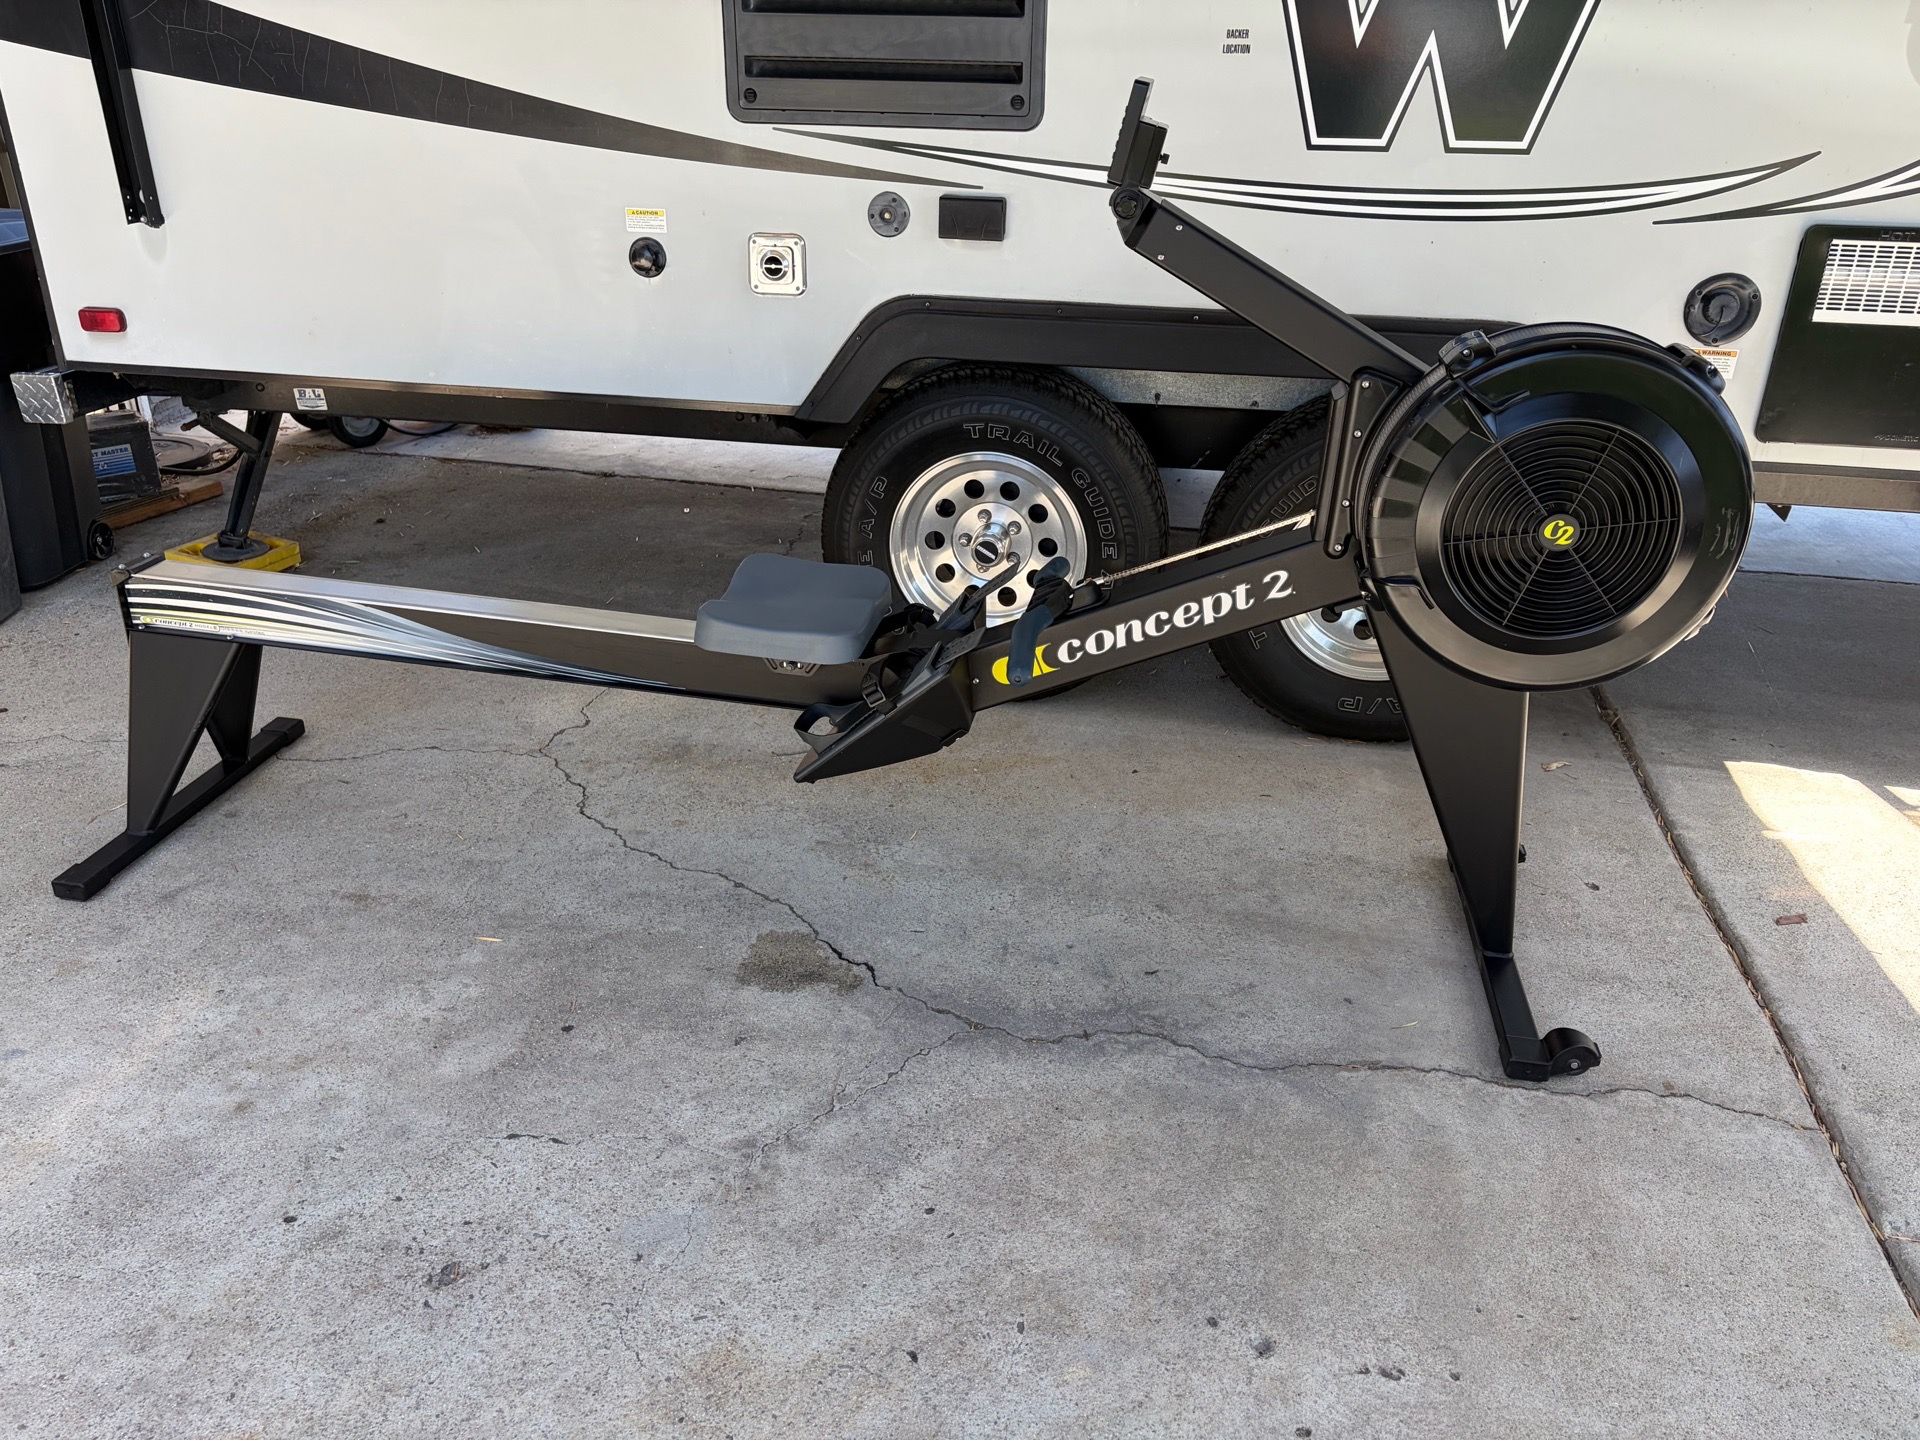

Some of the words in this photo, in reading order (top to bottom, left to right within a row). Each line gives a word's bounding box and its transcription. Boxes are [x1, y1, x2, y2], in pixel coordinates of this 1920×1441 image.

[1222, 43, 1251, 54] LOCATION
[1226, 28, 1250, 39] BACKER
[1282, 0, 1601, 155] W
[101, 446, 129, 456] MASTER
[857, 476, 888, 540] A/P
[963, 423, 1064, 467] TRAIL
[1071, 468, 1117, 560] GUIDE
[1543, 519, 1575, 546] C2
[1057, 583, 1255, 664] concept
[1262, 570, 1294, 602] 2
